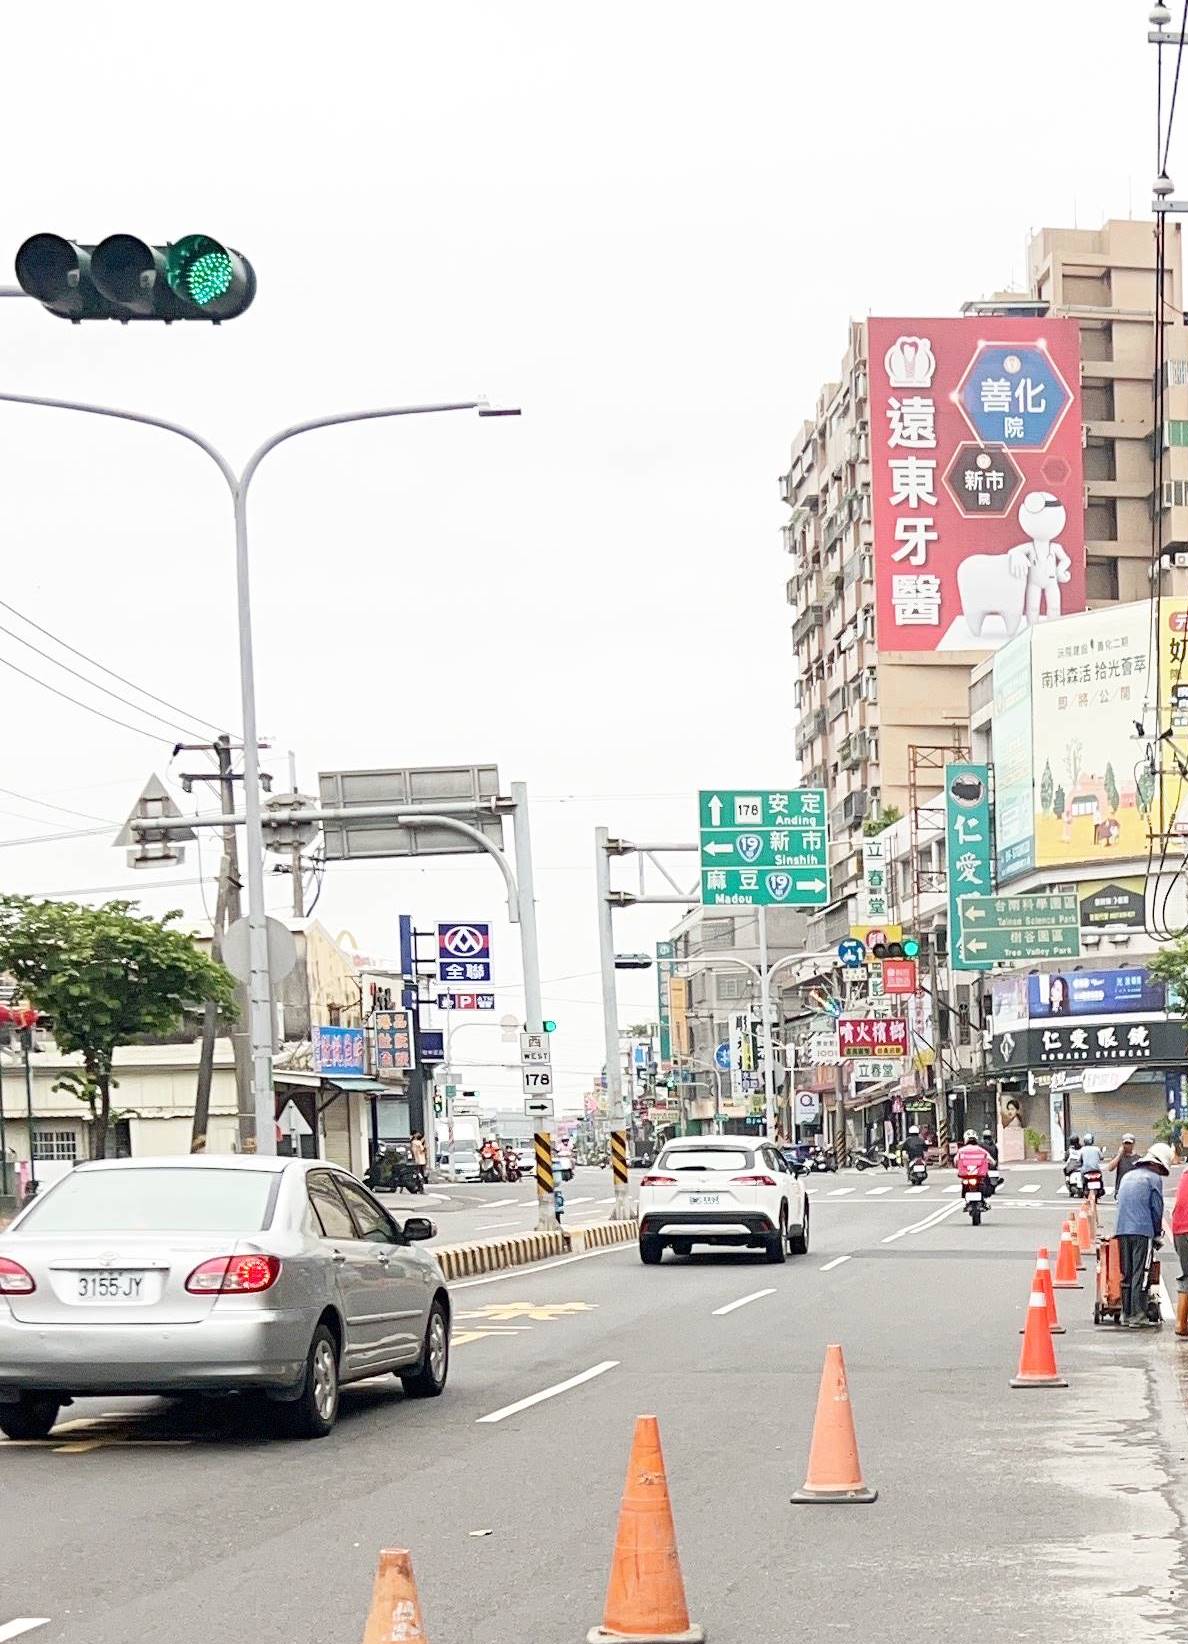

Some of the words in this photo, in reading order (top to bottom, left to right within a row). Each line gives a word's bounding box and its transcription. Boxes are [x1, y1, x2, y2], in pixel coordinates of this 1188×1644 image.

[980, 378, 1046, 413] 善化
[1004, 416, 1024, 439] 院
[964, 470, 1005, 491] 新市
[977, 492, 991, 505] 院
[885, 396, 942, 626] 遠東牙醫
[1041, 664, 1092, 689] 南科森活
[1095, 655, 1147, 681] 拾光薈萃
[738, 804, 759, 816] 178
[768, 793, 821, 815] 安定
[776, 815, 817, 827] Anding
[741, 837, 759, 849] 19
[770, 831, 822, 852] 新市
[774, 854, 818, 866] Sinshih
[707, 870, 759, 891] 麻豆
[770, 875, 789, 889] 19
[866, 841, 886, 915] 立春堂
[954, 814, 982, 960] 仁愛
[715, 893, 753, 905] Madou
[995, 896, 1076, 912] 台南科學園區
[1025, 915, 1056, 925] Science
[1059, 914, 1077, 924] Park
[1004, 948, 1022, 957] Tree
[1025, 947, 1050, 957] Valley
[1053, 946, 1073, 955] Park
[446, 964, 485, 980] 全聯
[460, 996, 472, 1008] P
[529, 1036, 541, 1048] 西
[840, 1021, 906, 1044] 噴火檳榔
[1042, 1025, 1150, 1051] 仁愛眼鏡
[525, 1074, 549, 1086] 178
[859, 1063, 894, 1078] 立春堂
[79, 1278, 142, 1297] 3155-JY
